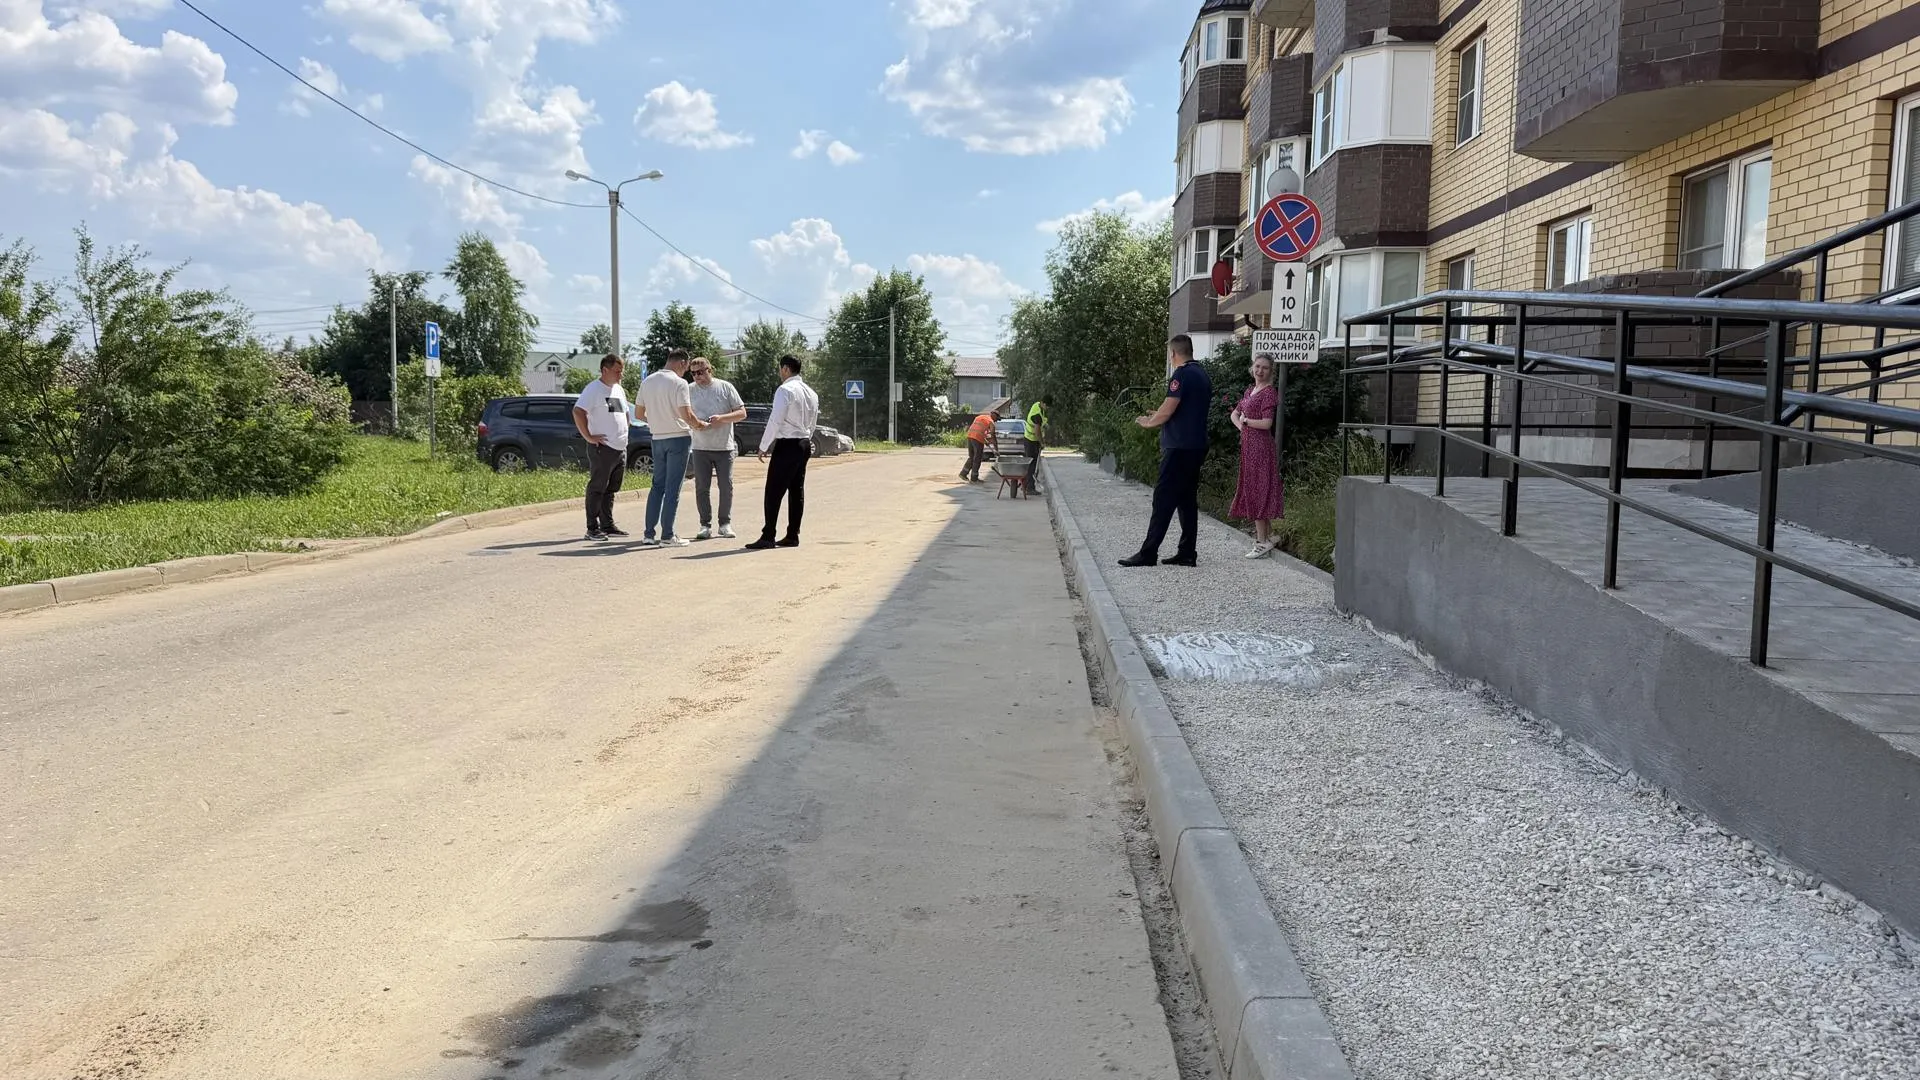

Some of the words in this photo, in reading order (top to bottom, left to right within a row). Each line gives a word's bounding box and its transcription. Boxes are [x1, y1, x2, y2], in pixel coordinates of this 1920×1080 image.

[1280, 296, 1296, 310] 10
[429, 326, 437, 355] P
[1255, 332, 1316, 342] ПЛОЩАДКА
[1255, 341, 1316, 351] ПОЖАРНОЙ
[1271, 352, 1309, 361] ХНИКИ
